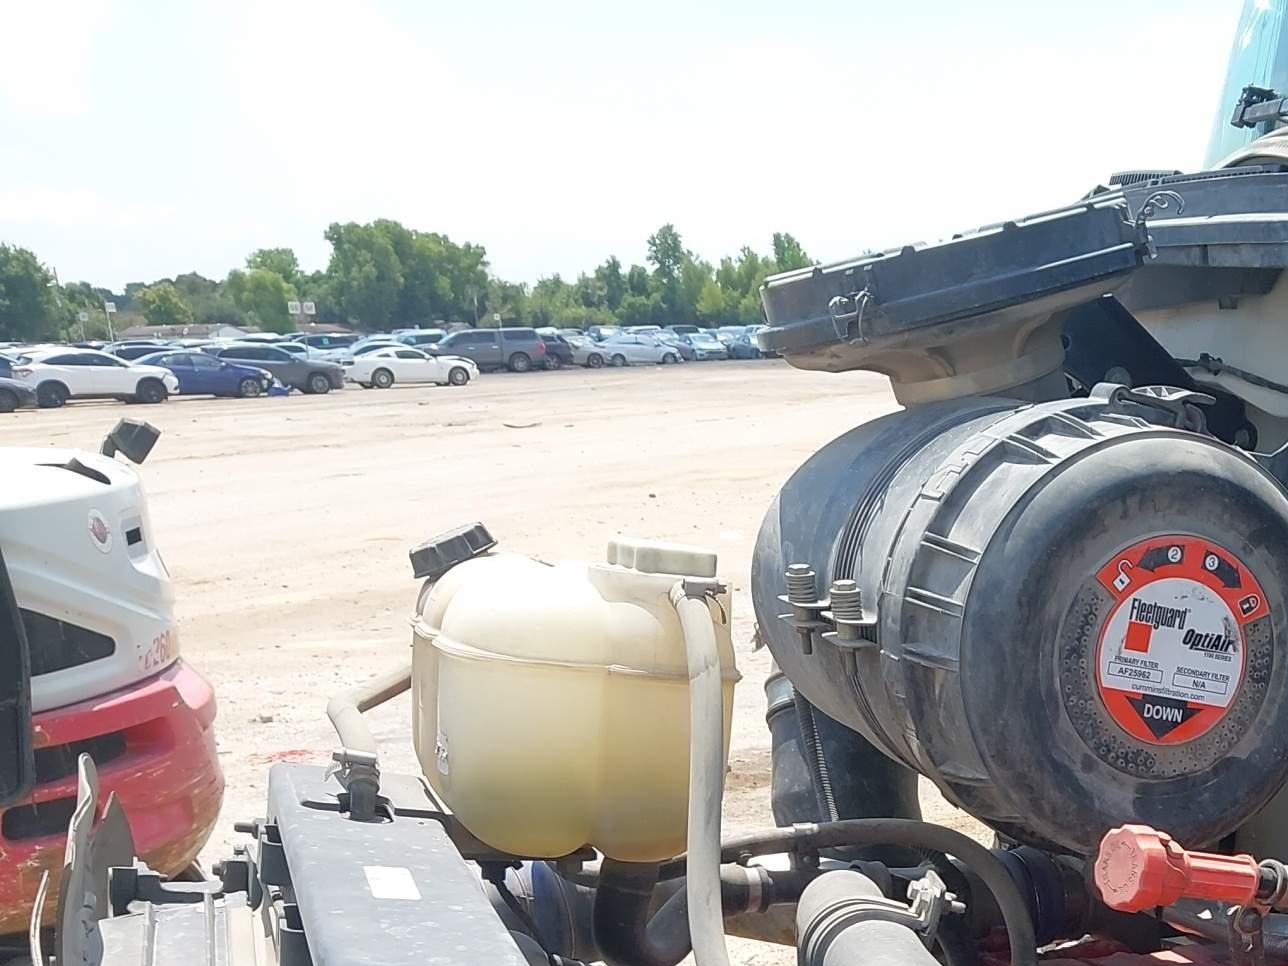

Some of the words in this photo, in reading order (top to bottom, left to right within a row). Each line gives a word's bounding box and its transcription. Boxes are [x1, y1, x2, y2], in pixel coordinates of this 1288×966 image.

[1171, 548, 1178, 560] 2
[1208, 556, 1216, 568] 3
[1182, 628, 1233, 652] OptiAir
[1114, 655, 1139, 666] PRIMARY
[1140, 660, 1159, 669] FILTER
[1118, 667, 1151, 679] AF25962
[1176, 666, 1210, 678] SECONDARY
[1211, 672, 1230, 681] FILTER
[1131, 683, 1205, 701] cumminsfiltration.com
[1192, 681, 1206, 689] N/A
[1143, 703, 1183, 722] DOWN
